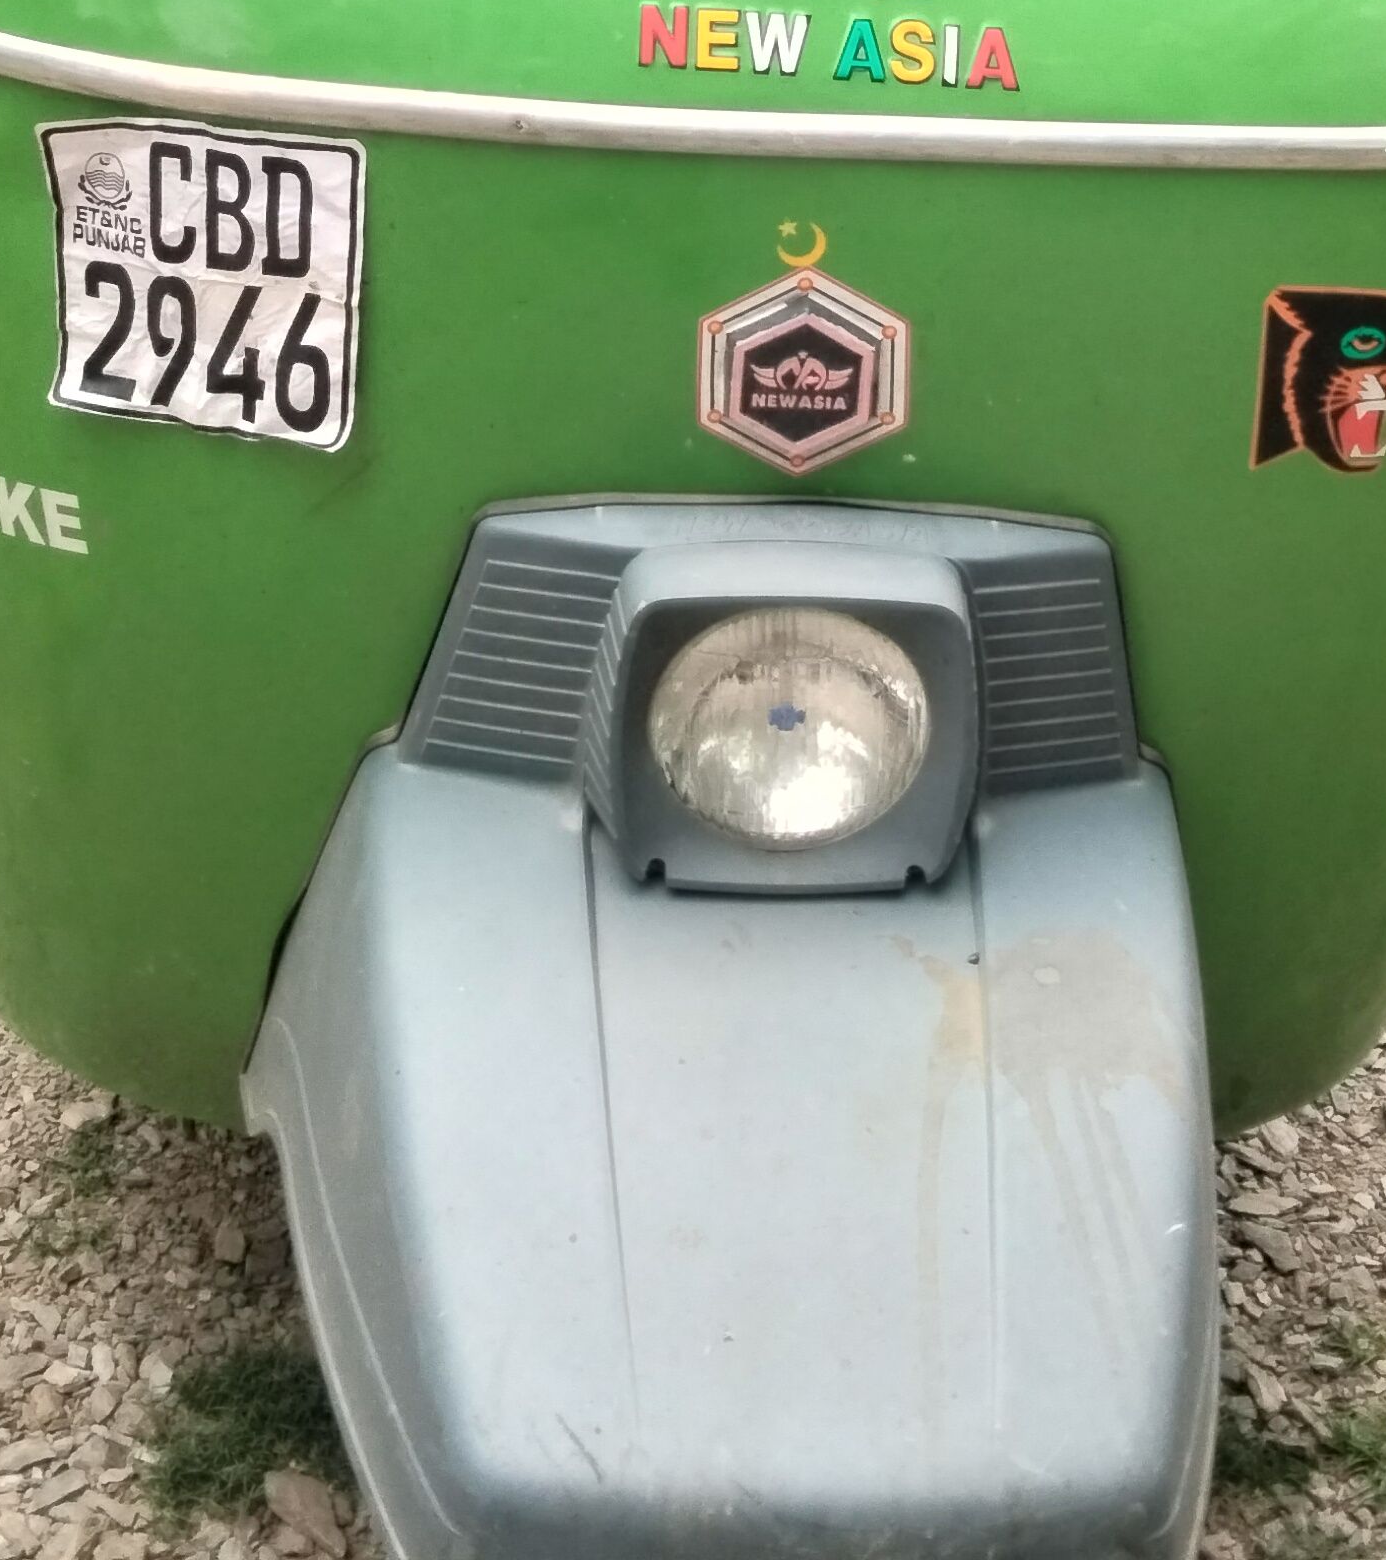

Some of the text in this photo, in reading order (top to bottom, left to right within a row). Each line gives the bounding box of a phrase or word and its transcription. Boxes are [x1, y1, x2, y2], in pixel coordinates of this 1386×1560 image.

[638, 3, 1021, 92] NEW ASIA
[72, 222, 146, 259] PUNJAB
[76, 205, 143, 235] ET&NC
[149, 141, 313, 278] CBD
[79, 260, 331, 432] 2946
